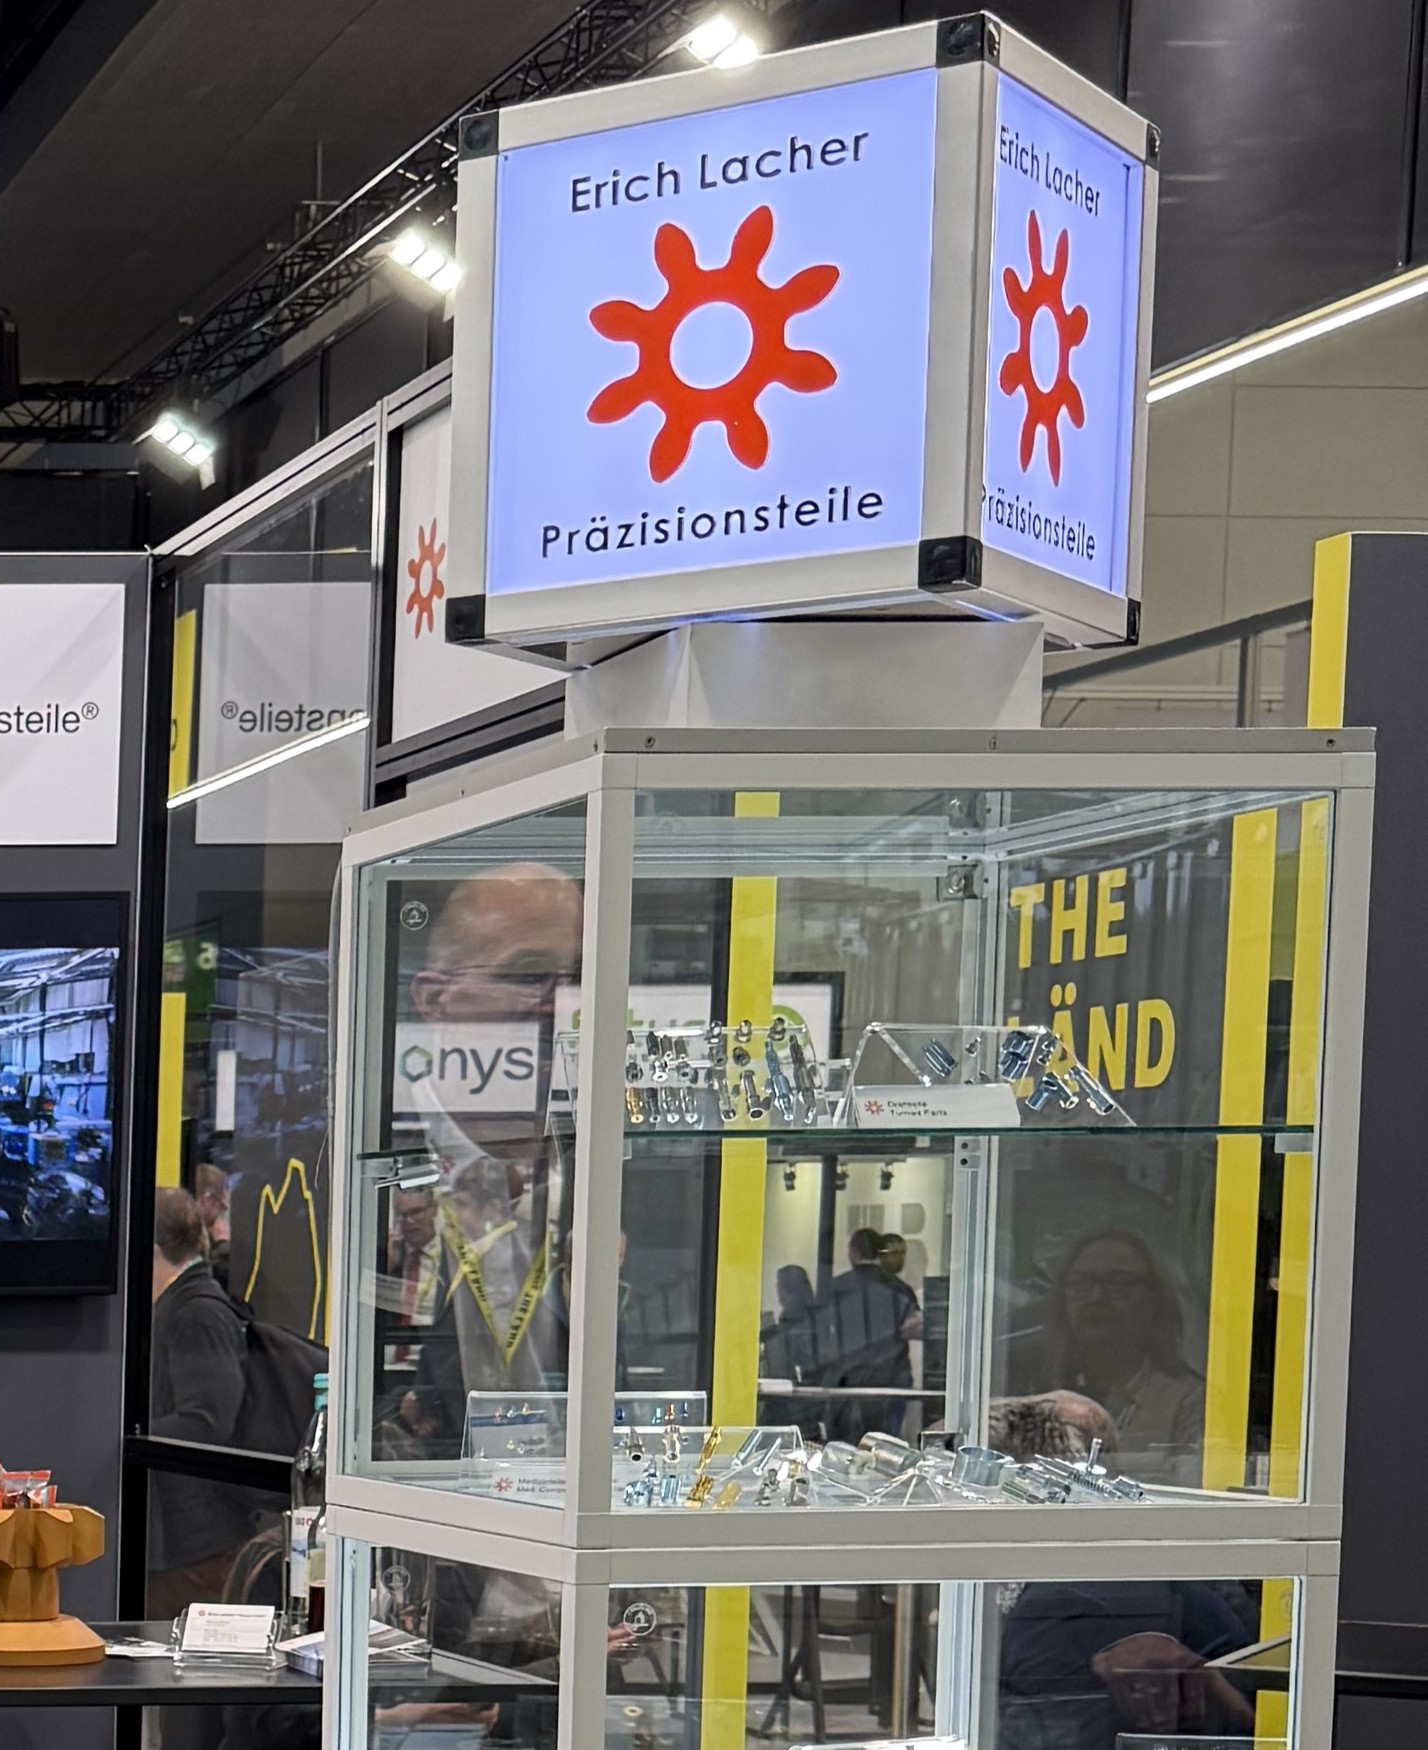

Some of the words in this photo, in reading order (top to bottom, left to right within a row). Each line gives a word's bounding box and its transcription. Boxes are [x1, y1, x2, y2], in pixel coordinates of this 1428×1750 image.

[571, 161, 681, 213] Erich
[699, 131, 870, 190] Lacher
[1000, 124, 1040, 183] Erich
[1045, 152, 1100, 217] Lacher
[541, 485, 885, 558] Präzisionsteile
[1010, 867, 1128, 969] THE
